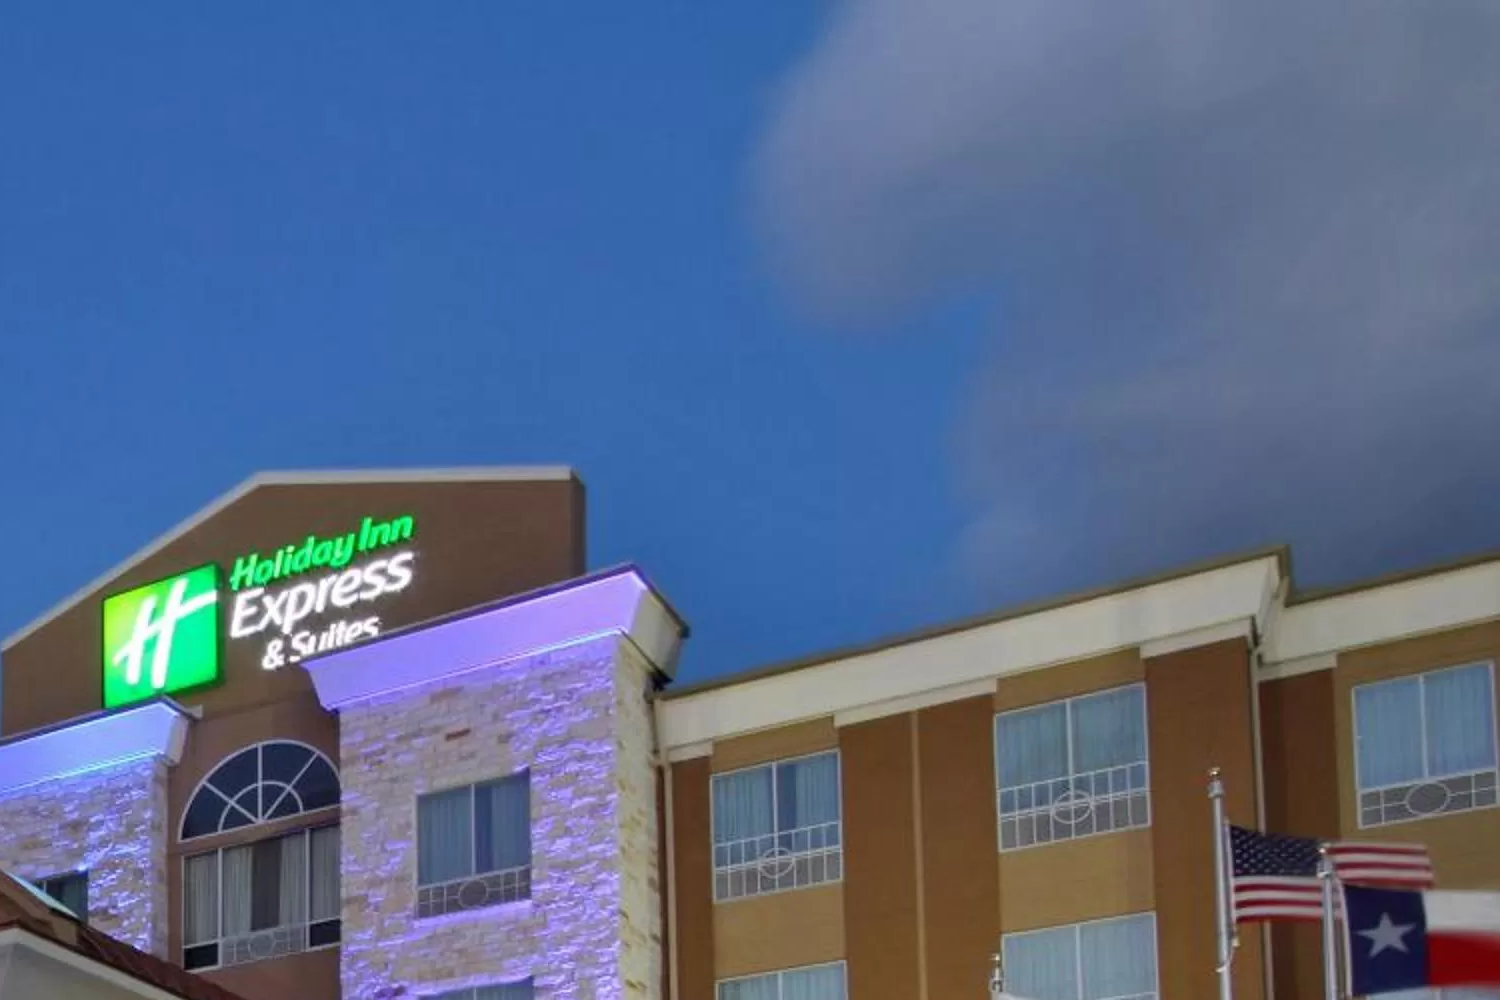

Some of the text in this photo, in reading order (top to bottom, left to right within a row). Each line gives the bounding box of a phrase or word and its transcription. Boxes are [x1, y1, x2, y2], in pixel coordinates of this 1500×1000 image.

[230, 516, 413, 591] Holiday Inn
[230, 551, 414, 638] Express
[261, 616, 381, 670] & Suites
